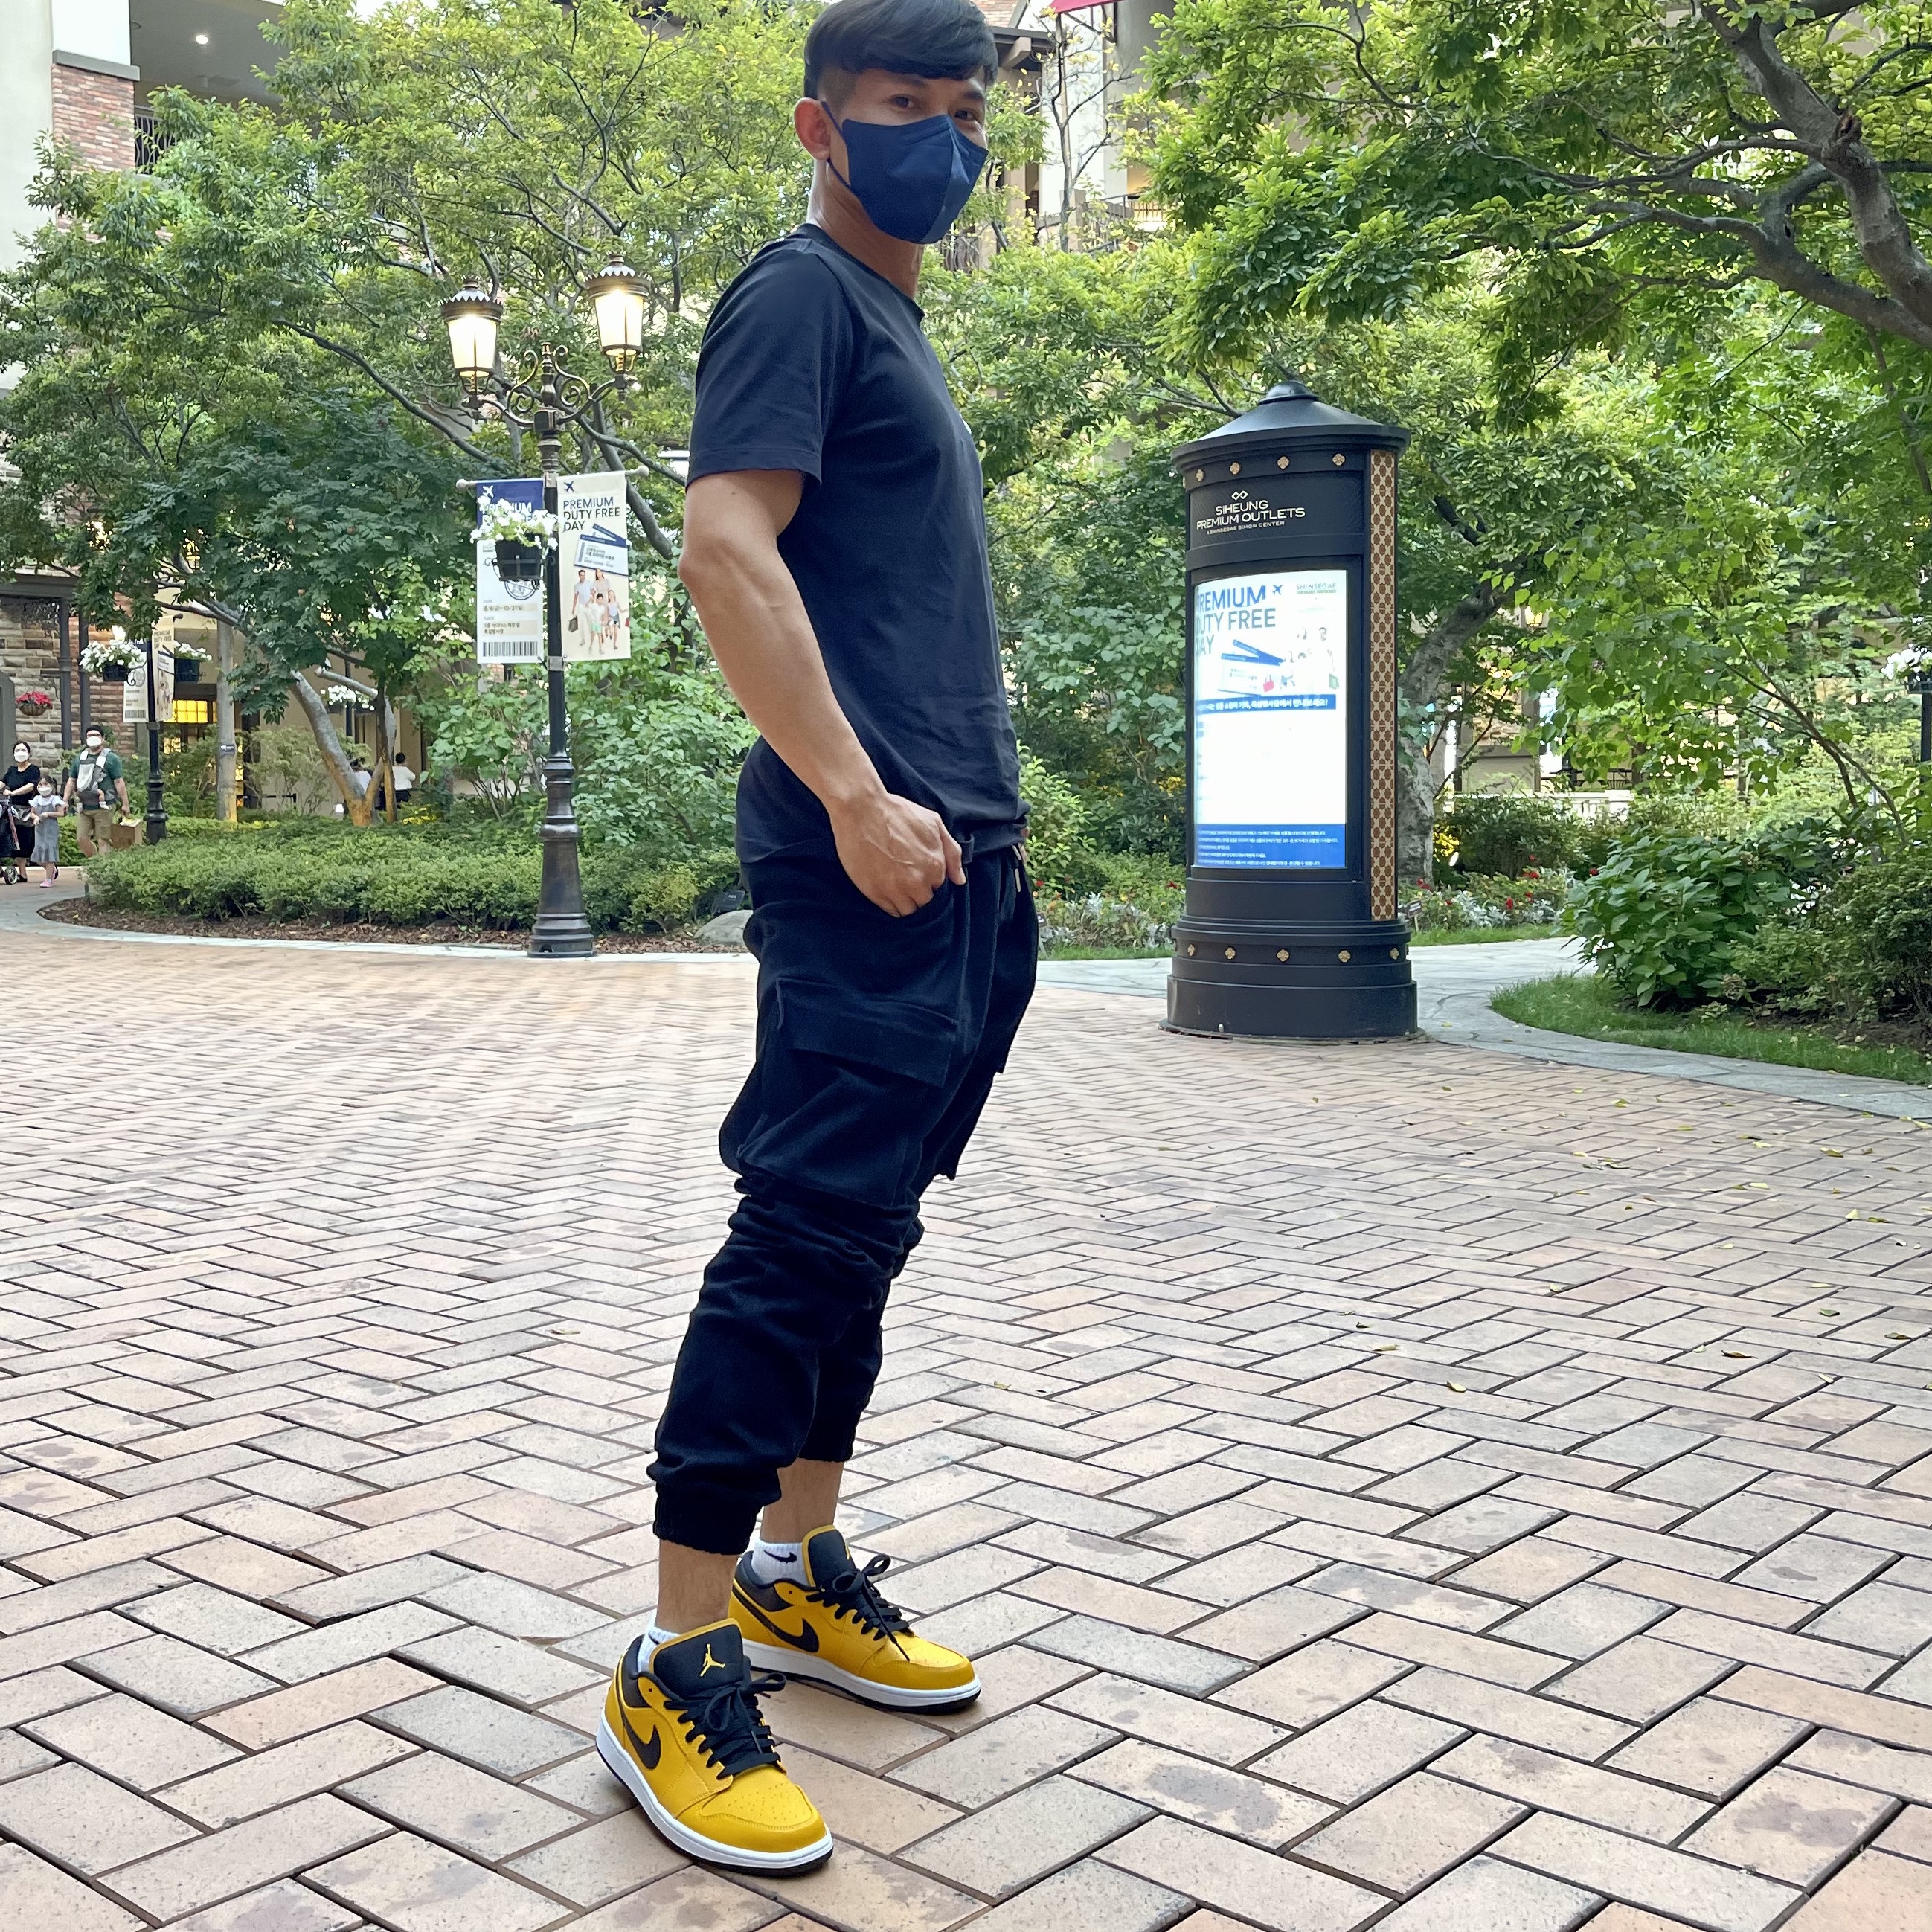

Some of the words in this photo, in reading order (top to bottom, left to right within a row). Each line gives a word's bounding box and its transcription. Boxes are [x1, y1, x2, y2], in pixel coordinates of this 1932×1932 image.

[563, 496, 614, 510] PREMIUM
[1216, 500, 1269, 516] SIHEUNG
[563, 509, 592, 520] DUTY
[595, 507, 620, 519] FREE
[1196, 514, 1239, 530] PREMIUM
[1242, 507, 1306, 522] OUTLETS
[563, 521, 585, 533] DAY
[1238, 523, 1257, 531] SIMON
[1258, 521, 1285, 529] CENTER
[1228, 608, 1276, 630] FREE
